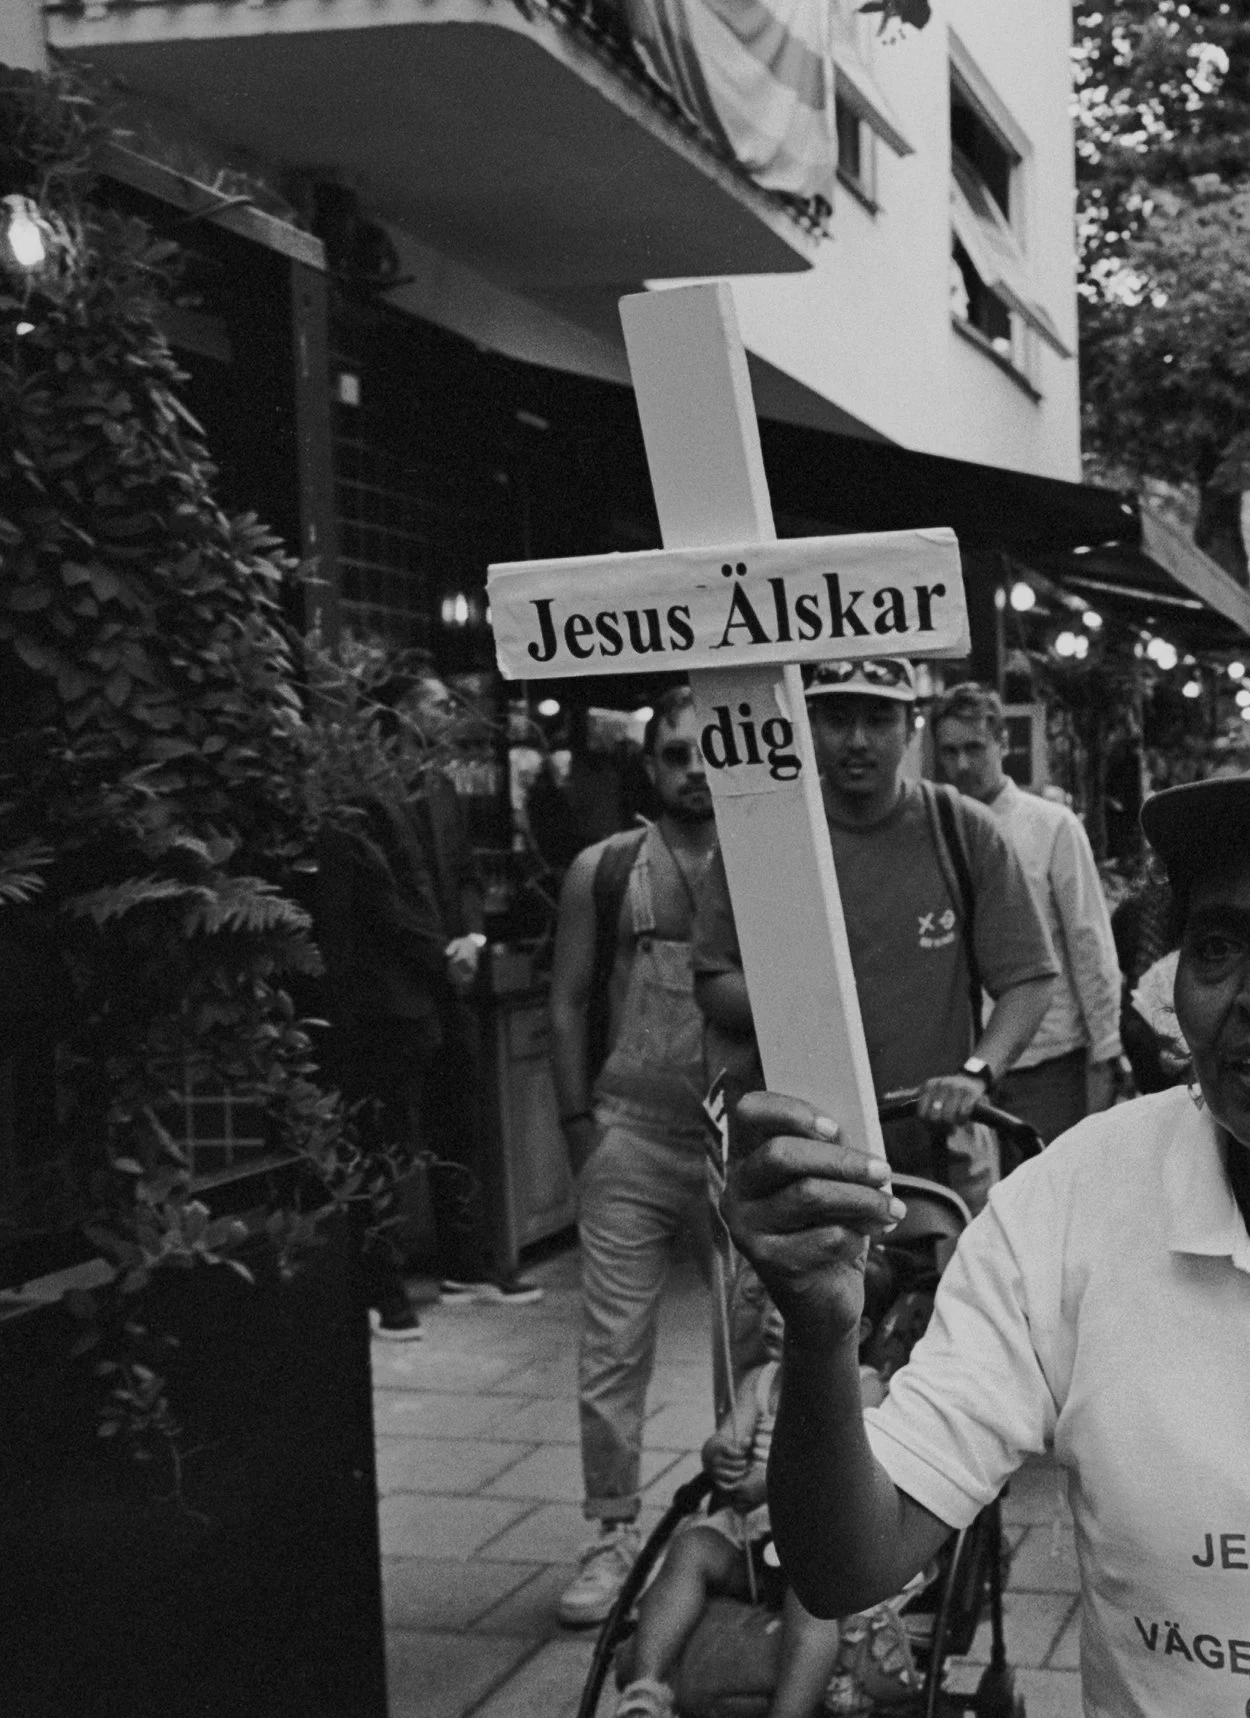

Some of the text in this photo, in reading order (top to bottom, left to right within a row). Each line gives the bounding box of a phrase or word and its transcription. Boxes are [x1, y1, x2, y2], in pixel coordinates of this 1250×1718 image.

[527, 562, 946, 662] Jesus Älskar
[700, 702, 802, 781] dig
